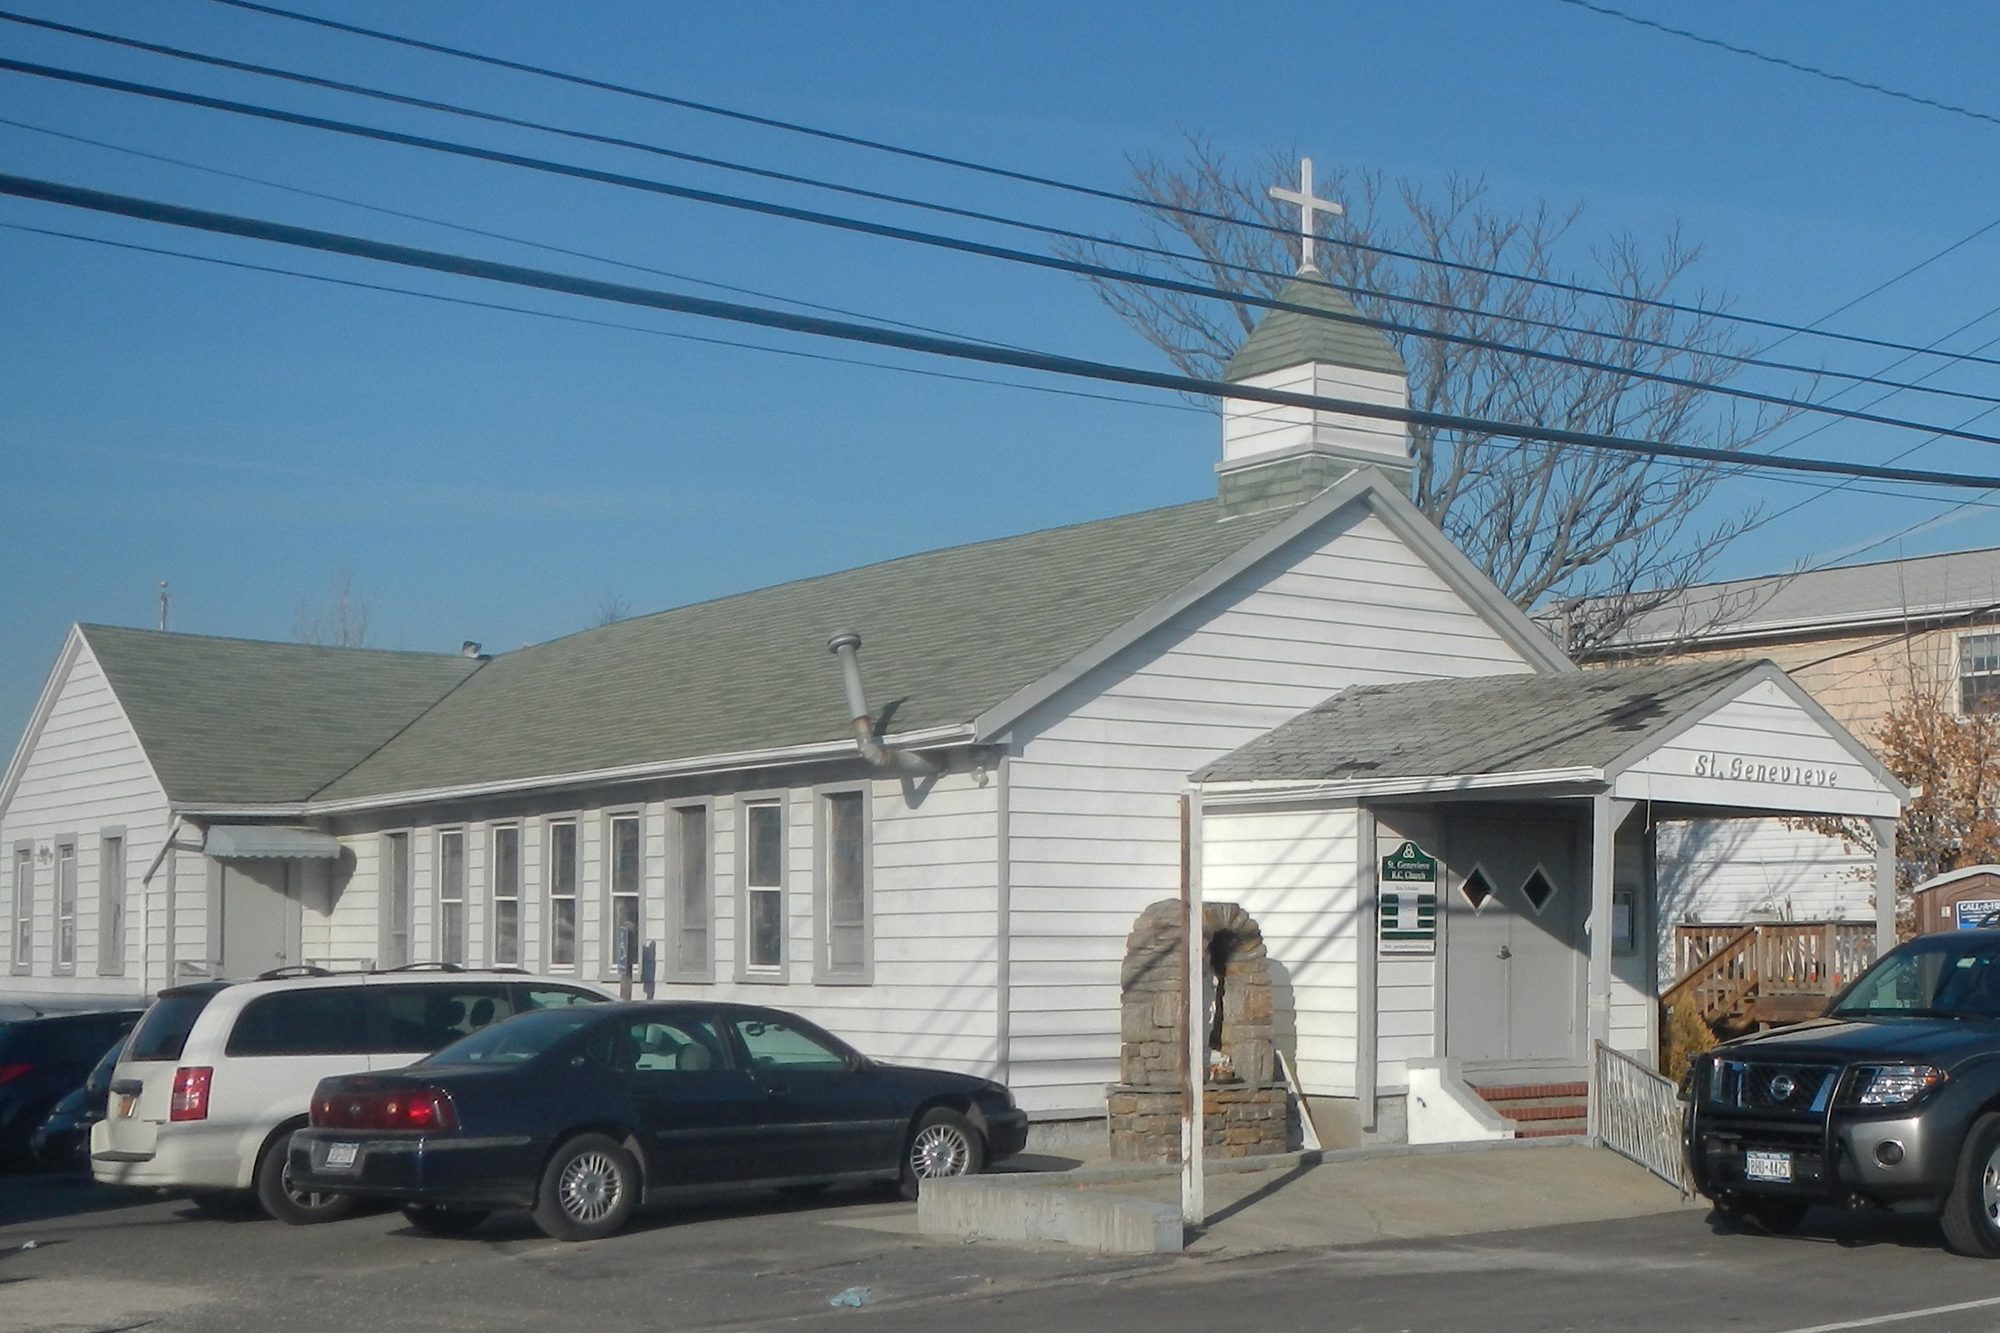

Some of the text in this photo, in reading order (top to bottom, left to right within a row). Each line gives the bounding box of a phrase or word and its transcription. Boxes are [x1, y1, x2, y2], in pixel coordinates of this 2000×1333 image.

[1694, 751, 1838, 787] St. Genevieve
[1397, 860, 1430, 870] Genevieve
[1404, 870, 1426, 880] Church
